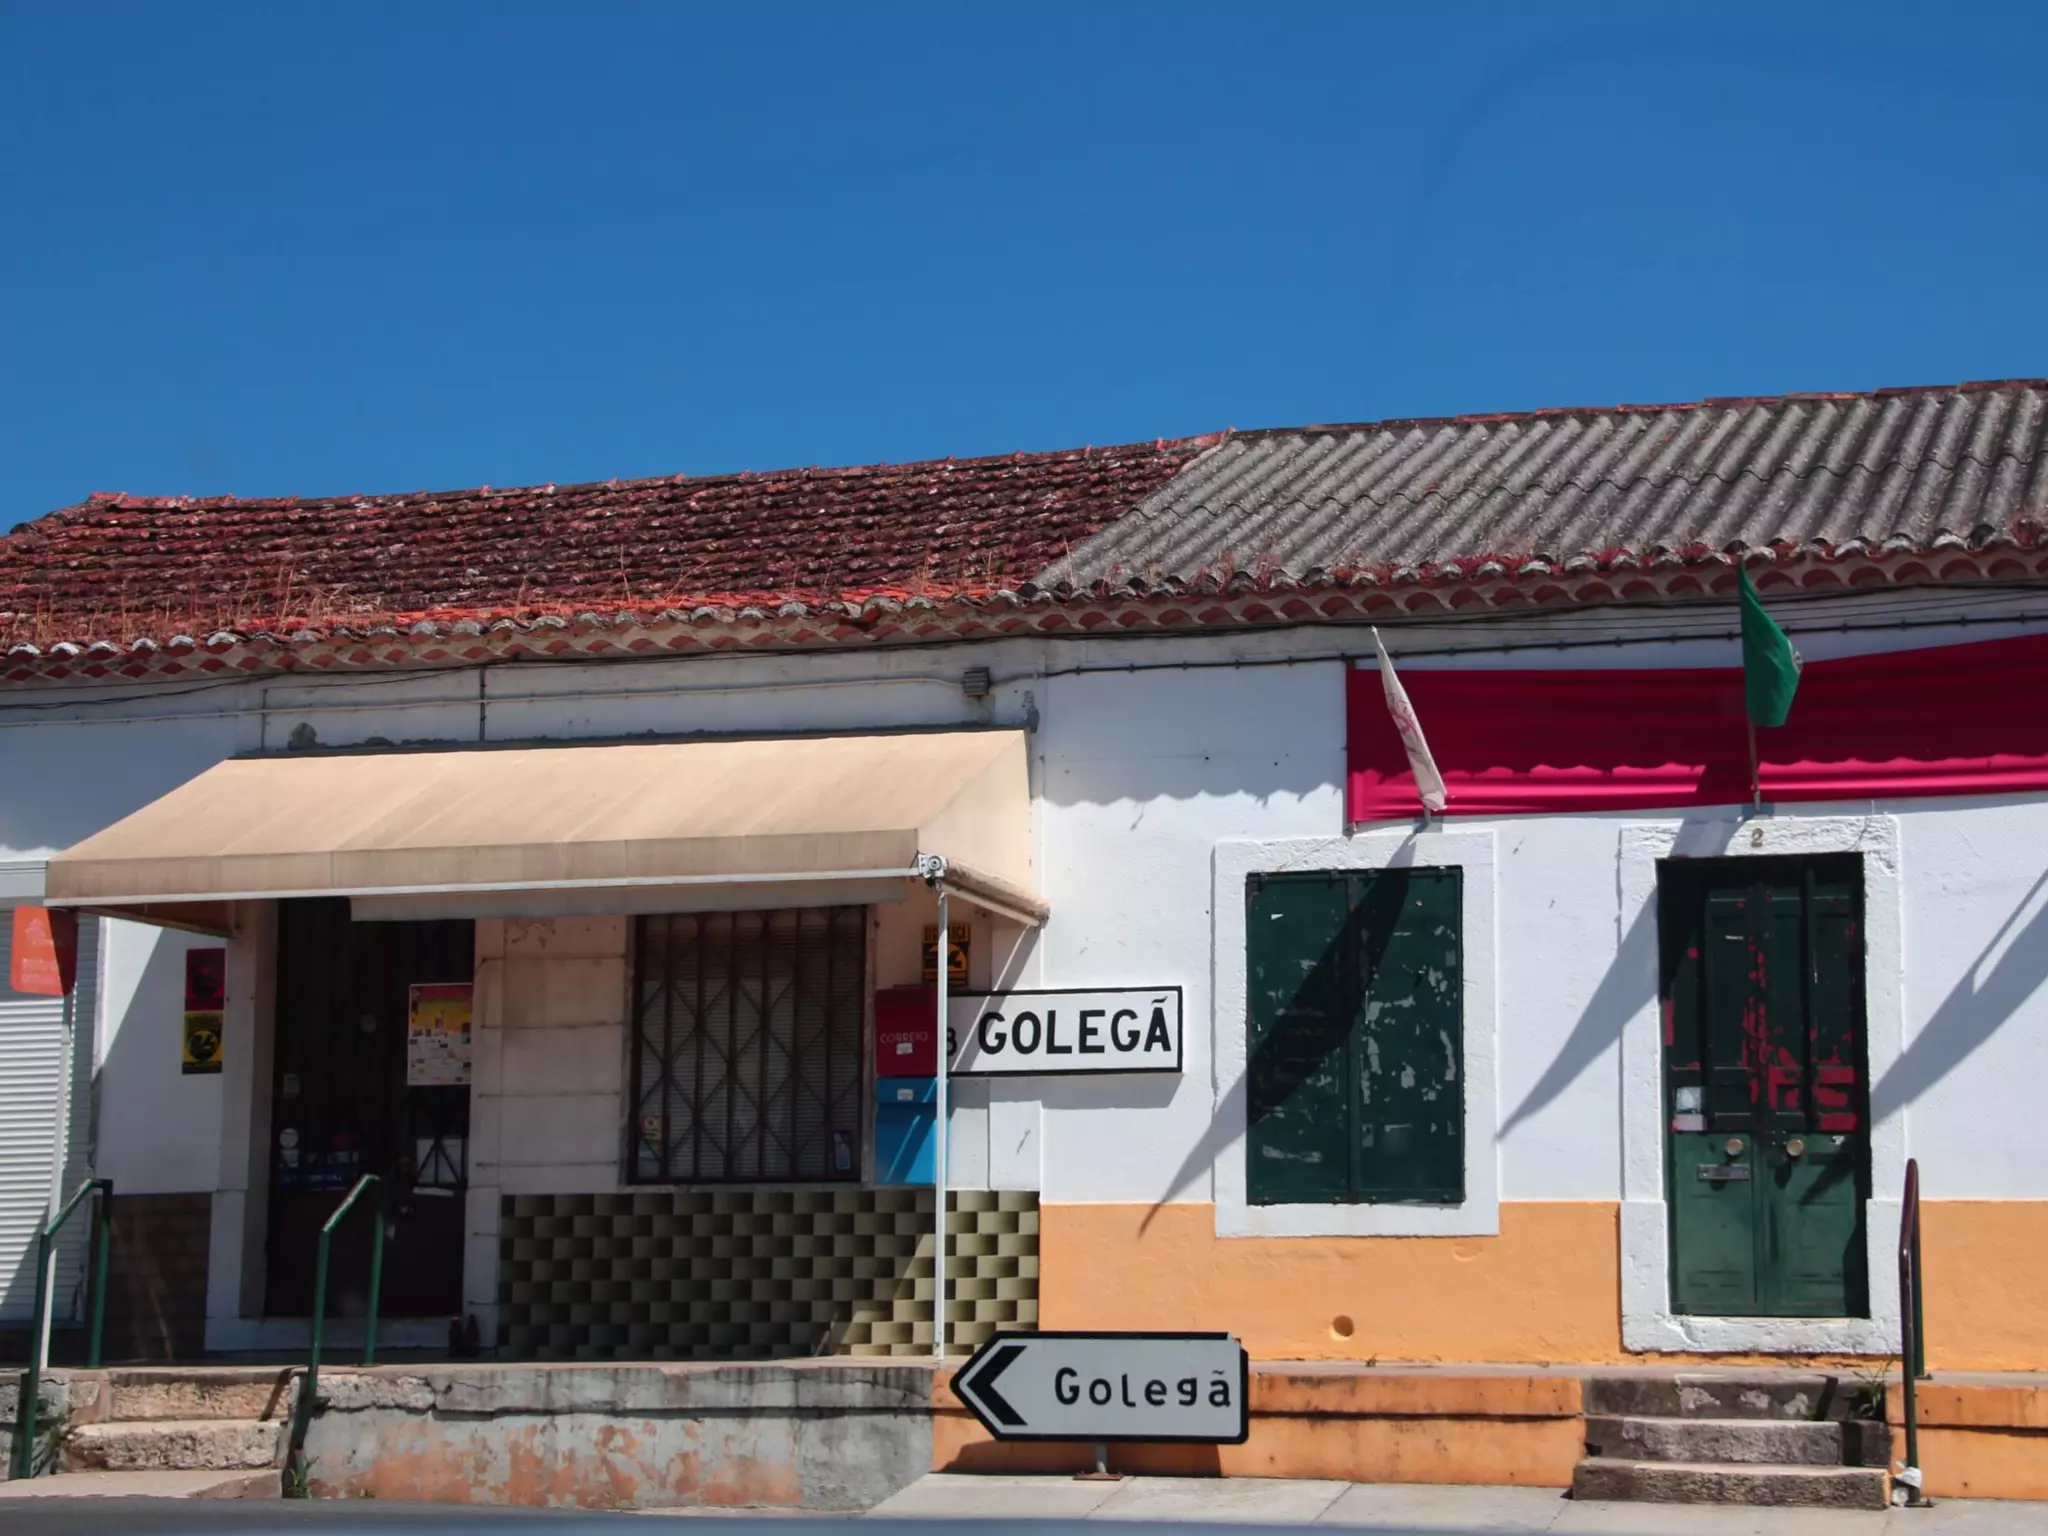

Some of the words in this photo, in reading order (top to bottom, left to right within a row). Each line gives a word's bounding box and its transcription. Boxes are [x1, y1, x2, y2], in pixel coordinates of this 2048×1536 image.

[1751, 827, 1764, 848] 2
[880, 1031, 929, 1044] CORREIO
[978, 996, 1172, 1056] GOLEGÃ
[1055, 1367, 1231, 1409] Golegã
